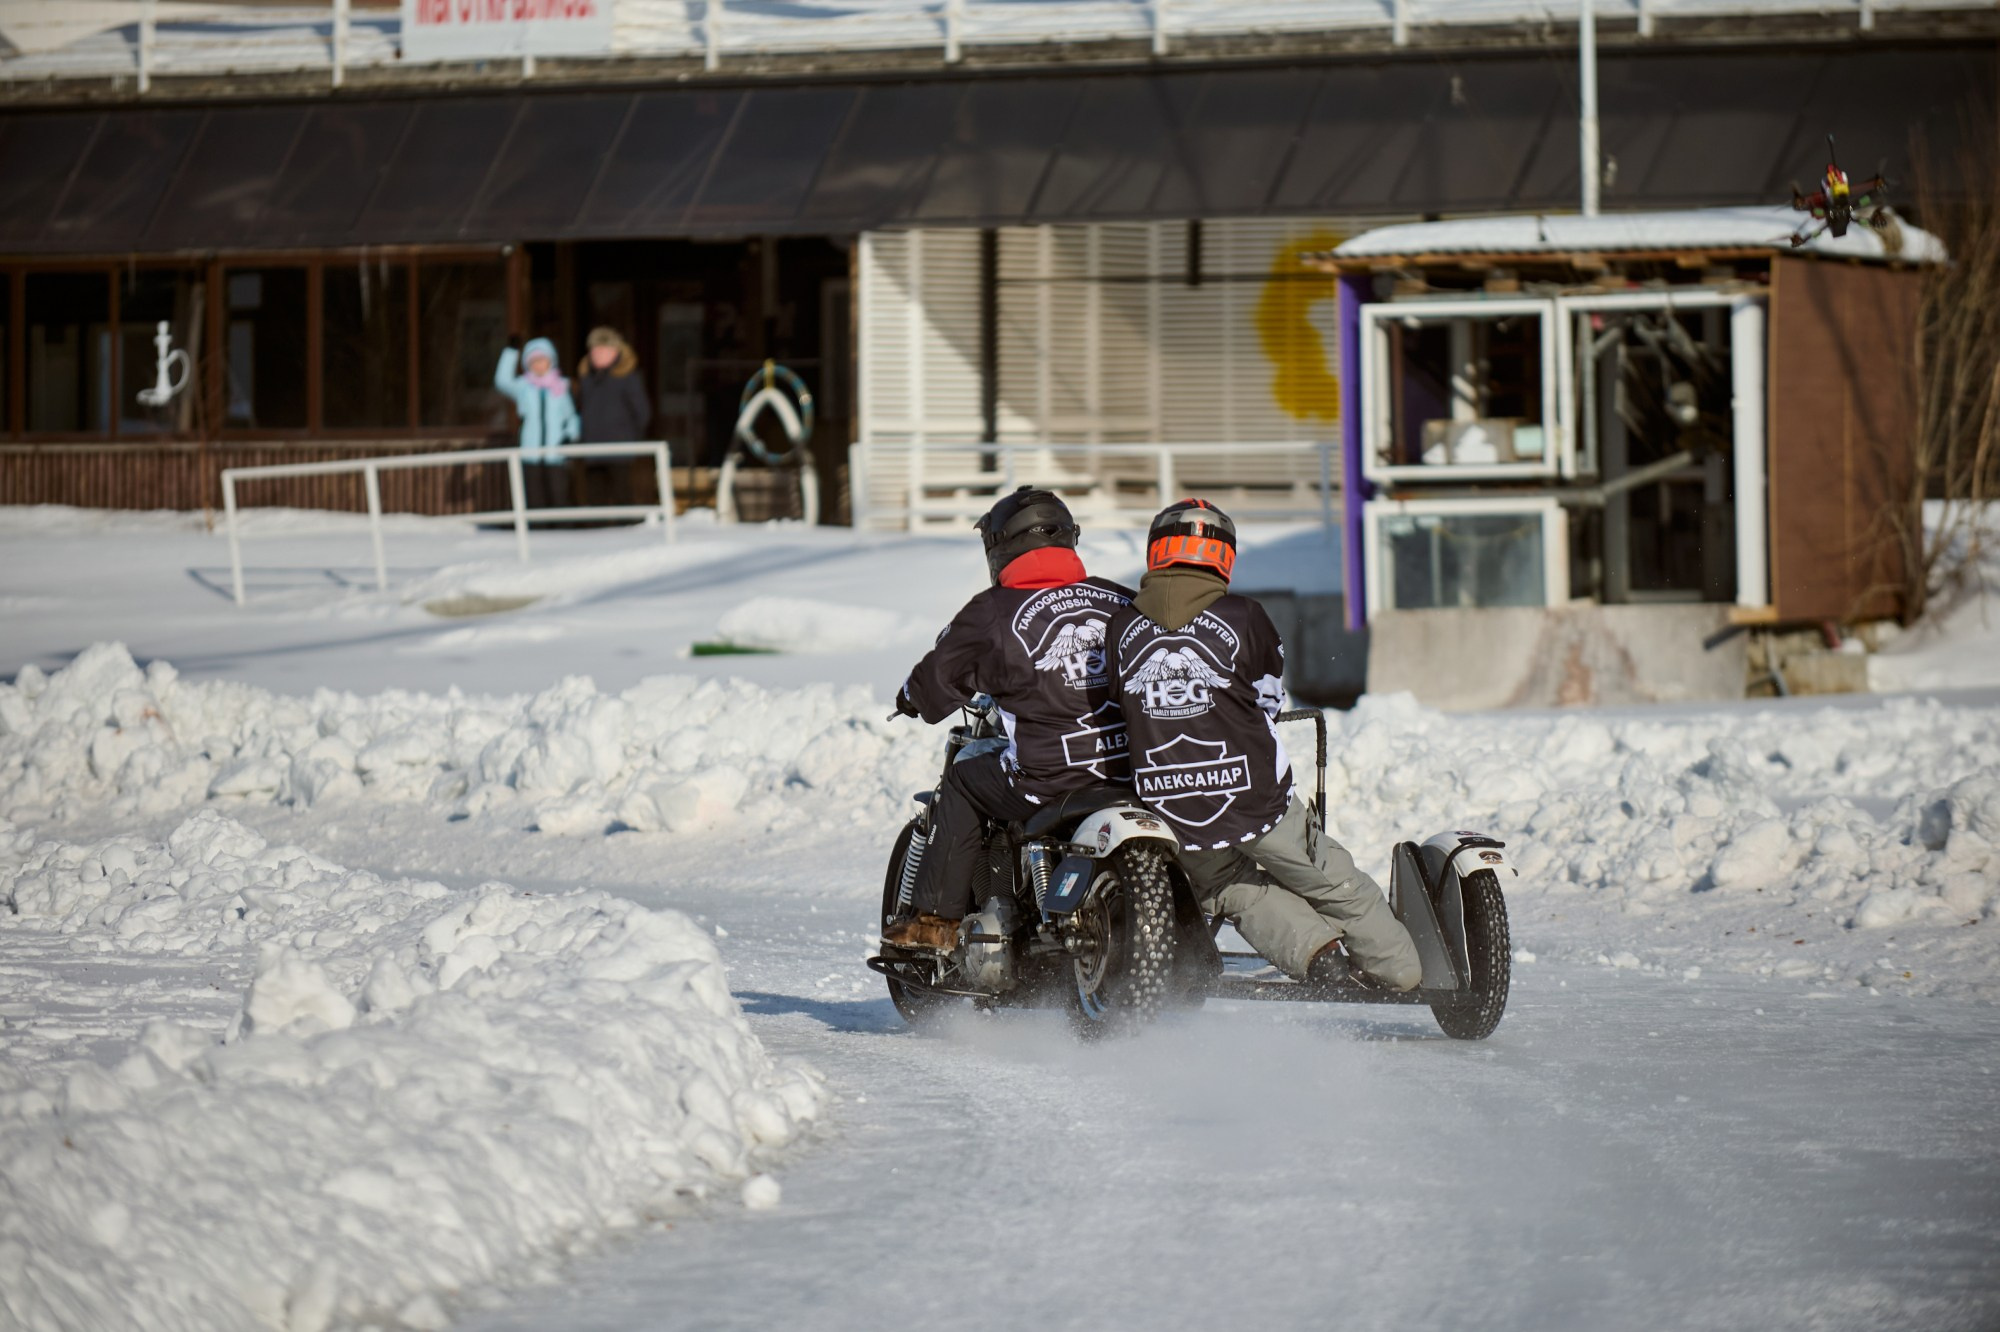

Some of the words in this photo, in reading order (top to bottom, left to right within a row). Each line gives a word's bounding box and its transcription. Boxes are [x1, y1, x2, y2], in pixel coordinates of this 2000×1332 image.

[1017, 587, 1074, 632] TANKOGRAD
[1075, 588, 1130, 607] CHAPTER
[1050, 598, 1093, 614] RUSSIA
[1120, 618, 1156, 650] TANKO
[1192, 615, 1236, 647] HAPTER
[1144, 678, 1210, 708] HOG
[1152, 708, 1170, 717] HARLEY
[1170, 708, 1190, 717] OWNERS
[1190, 703, 1206, 715] GROUP
[1143, 766, 1243, 792] АЛЕКСАНДР
